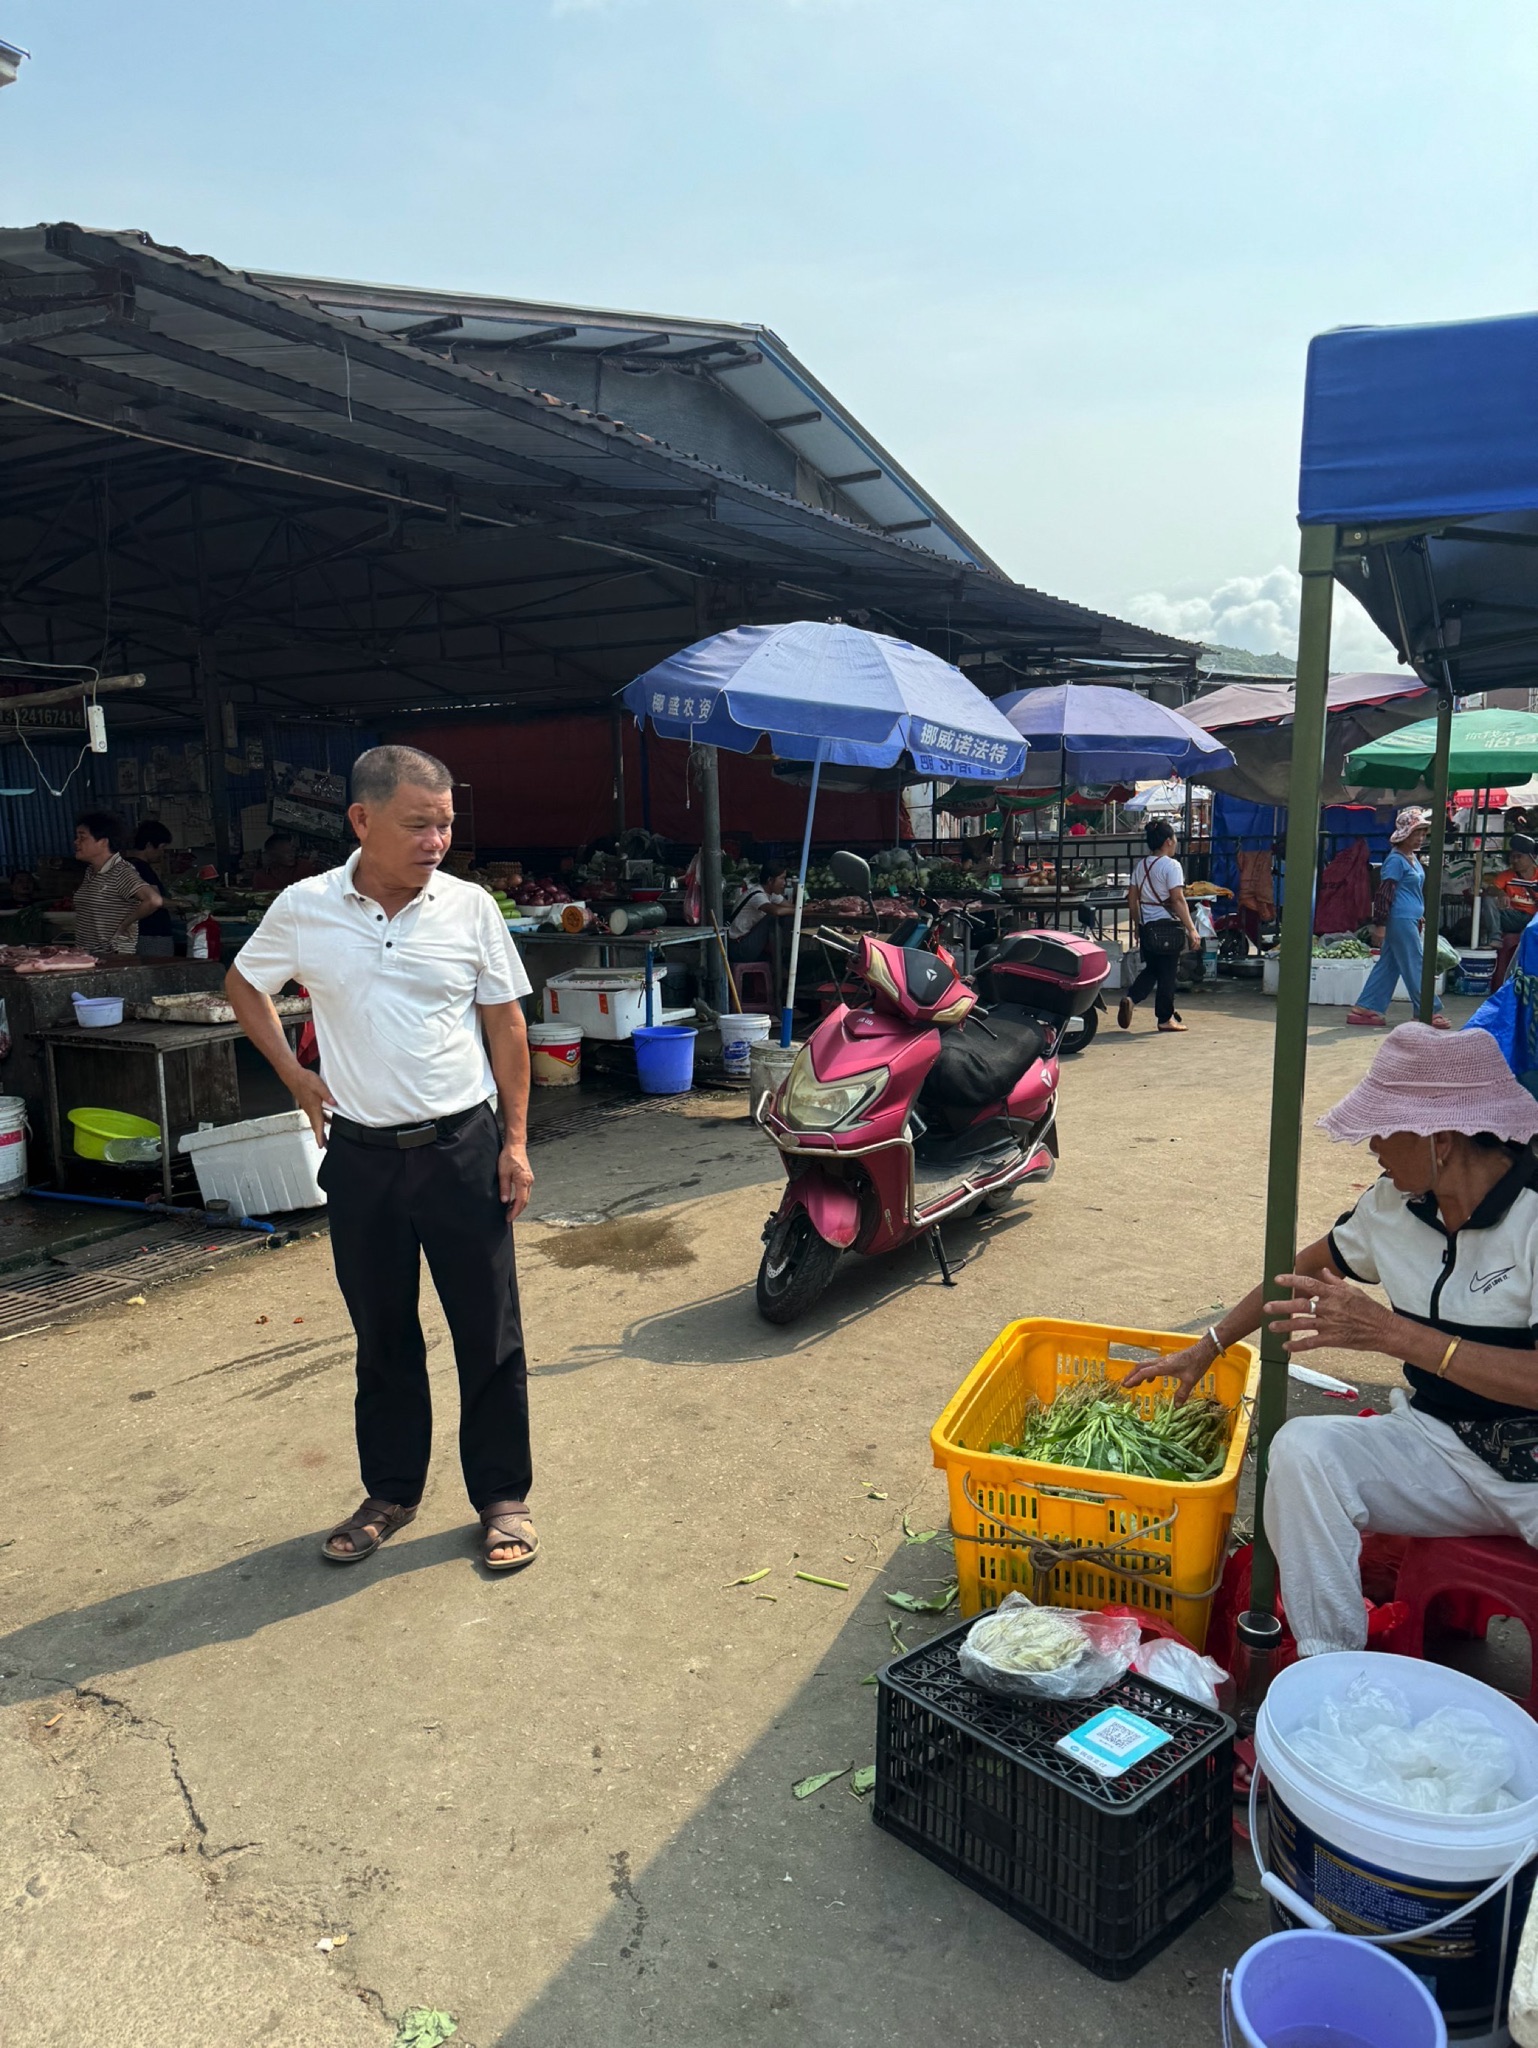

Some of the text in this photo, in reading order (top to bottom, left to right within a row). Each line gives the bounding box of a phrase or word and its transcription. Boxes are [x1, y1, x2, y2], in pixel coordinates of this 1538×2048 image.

[920, 723, 1008, 764] 挪威诺法特
